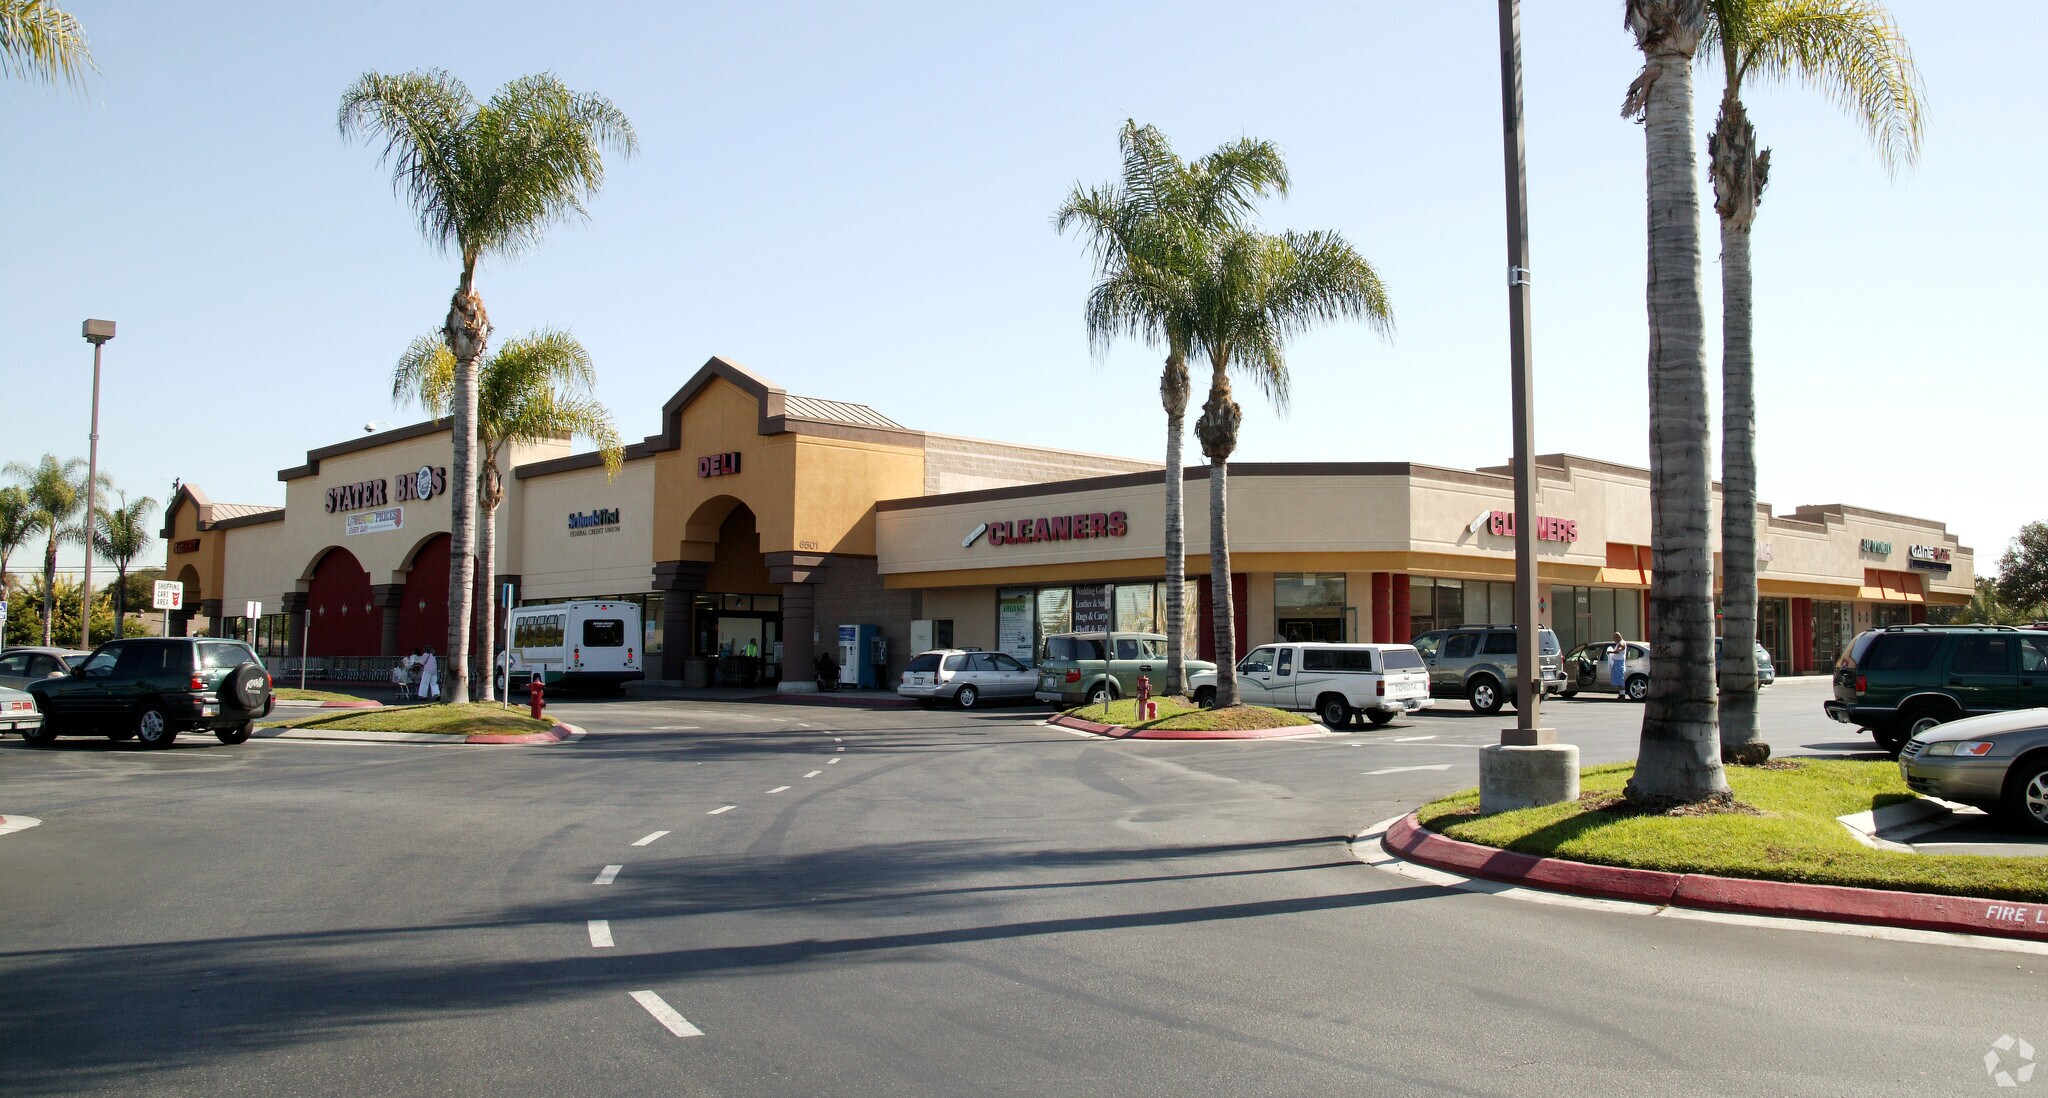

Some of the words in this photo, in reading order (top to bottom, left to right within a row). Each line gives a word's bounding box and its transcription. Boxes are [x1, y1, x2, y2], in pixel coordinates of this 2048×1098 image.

[698, 451, 741, 478] DELI
[325, 478, 388, 513] STATER
[394, 465, 447, 502] BROS
[375, 509, 397, 523] PRICES
[568, 507, 620, 529] SchoolsFirst
[570, 530, 588, 538] FEDERAL
[588, 528, 605, 536] CREDIT
[605, 525, 620, 533] UNION
[987, 511, 1128, 546] CLEANERS
[1487, 510, 1578, 543] CLNERS
[799, 540, 819, 550] 6501
[157, 582, 180, 591] SHOPPING
[1075, 586, 1095, 597] Wedding
[157, 590, 169, 598] CART
[156, 598, 169, 606] AREA
[1075, 599, 1092, 608] Leather
[1092, 599, 1098, 608] &
[1075, 612, 1088, 622] Rugs
[1088, 611, 1094, 621] &
[1395, 683, 1417, 692] TOYOTA
[1986, 905, 2027, 922] FIRE
[2035, 909, 2048, 924] L
